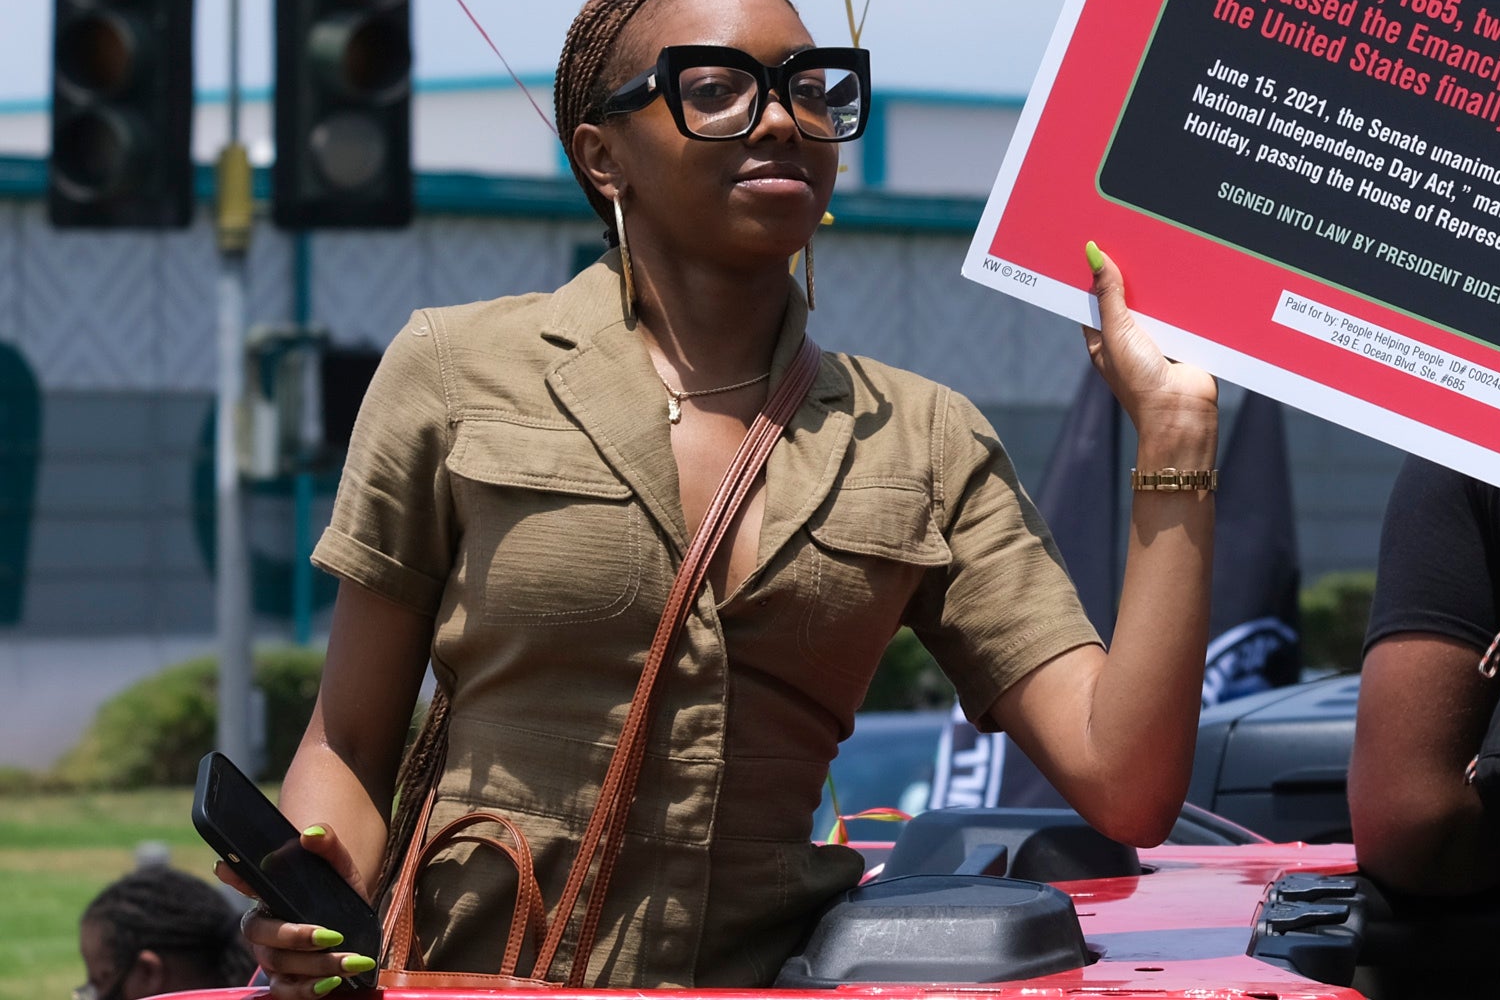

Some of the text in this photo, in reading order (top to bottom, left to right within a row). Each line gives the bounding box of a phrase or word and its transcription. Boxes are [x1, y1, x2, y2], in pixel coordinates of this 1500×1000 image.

[1260, 8, 1346, 63] United
[1349, 42, 1430, 95] States
[1360, 6, 1401, 43] the
[1192, 83, 1265, 126] National
[1266, 112, 1384, 171] Independence
[1387, 158, 1423, 189] Day
[1207, 59, 1249, 88] June
[1254, 76, 1277, 103] 15,
[1283, 87, 1329, 122] 2021,
[1336, 107, 1364, 131] the
[1367, 118, 1427, 155] Senate
[1183, 112, 1250, 156] Holiday,
[1255, 144, 1323, 184] passing
[1326, 167, 1354, 192] the
[1357, 178, 1411, 214] House
[1414, 204, 1435, 222] of
[982, 258, 1001, 272] KW
[1013, 270, 1037, 287] 2021
[1217, 182, 1274, 215] SIGNED
[1276, 204, 1313, 230] INTO
[1315, 219, 1351, 244] LAW
[1351, 233, 1375, 253] BY
[1375, 242, 1462, 287] PRESIDENT
[1285, 296, 1307, 313] Paid
[1307, 305, 1322, 319] for
[1323, 311, 1339, 326] by:
[1340, 317, 1372, 339] People
[1374, 331, 1410, 356] Helping
[1411, 345, 1444, 367] People
[1448, 360, 1467, 374] ID#
[1330, 330, 1465, 391] 249 E. Ocean Blvd. Ste. #685
